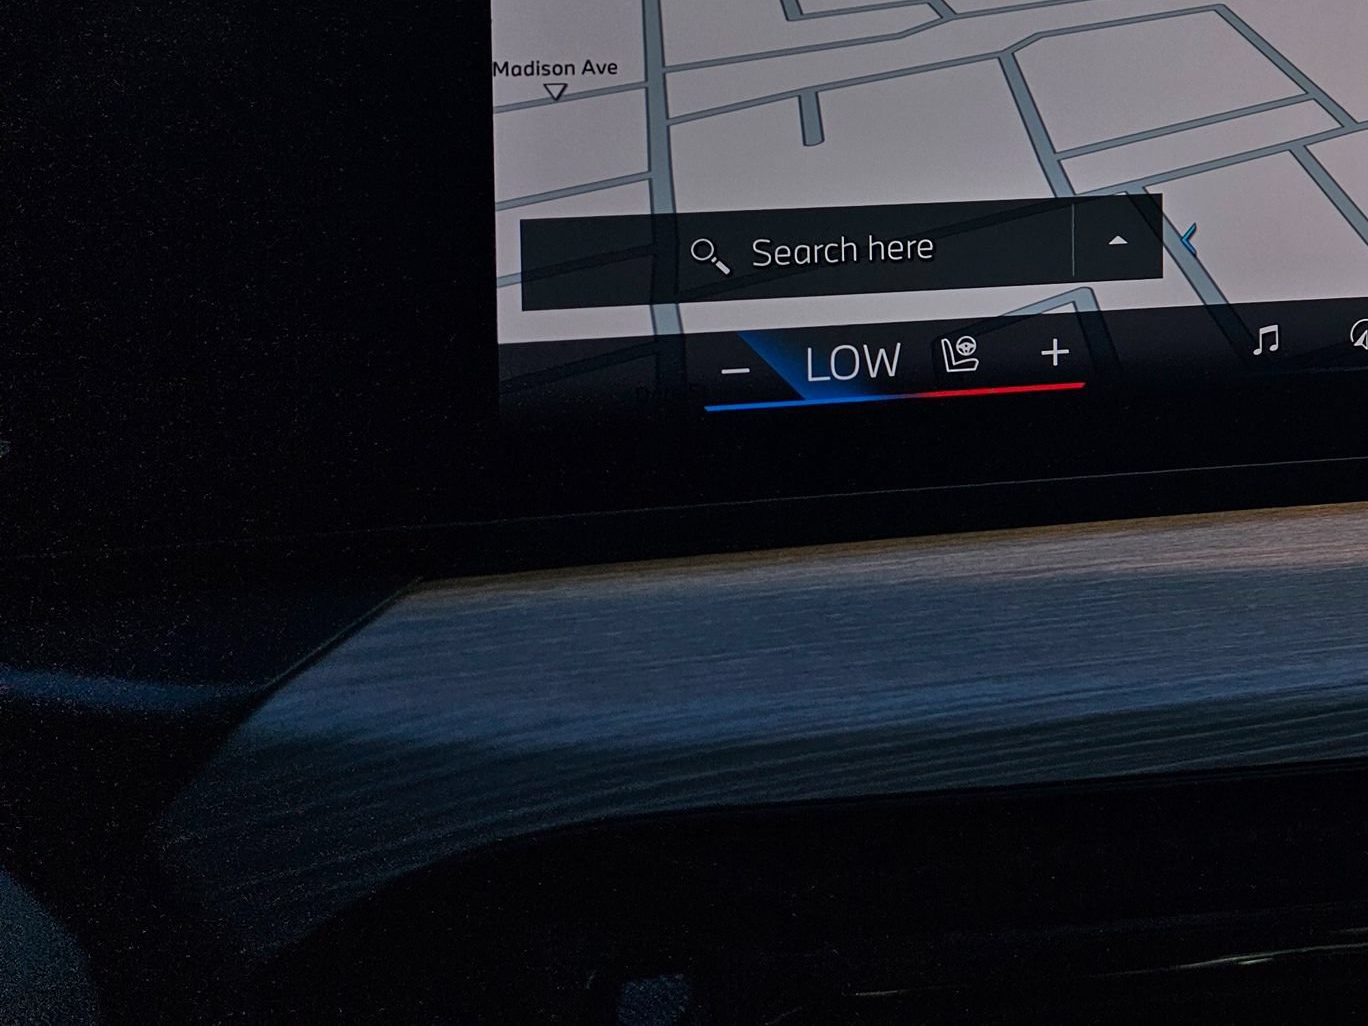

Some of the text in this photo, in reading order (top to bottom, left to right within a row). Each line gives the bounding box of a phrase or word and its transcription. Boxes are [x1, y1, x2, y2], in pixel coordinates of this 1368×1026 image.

[492, 59, 618, 77] Madison Ave
[752, 234, 934, 267] Search here
[807, 342, 902, 382] LOW
